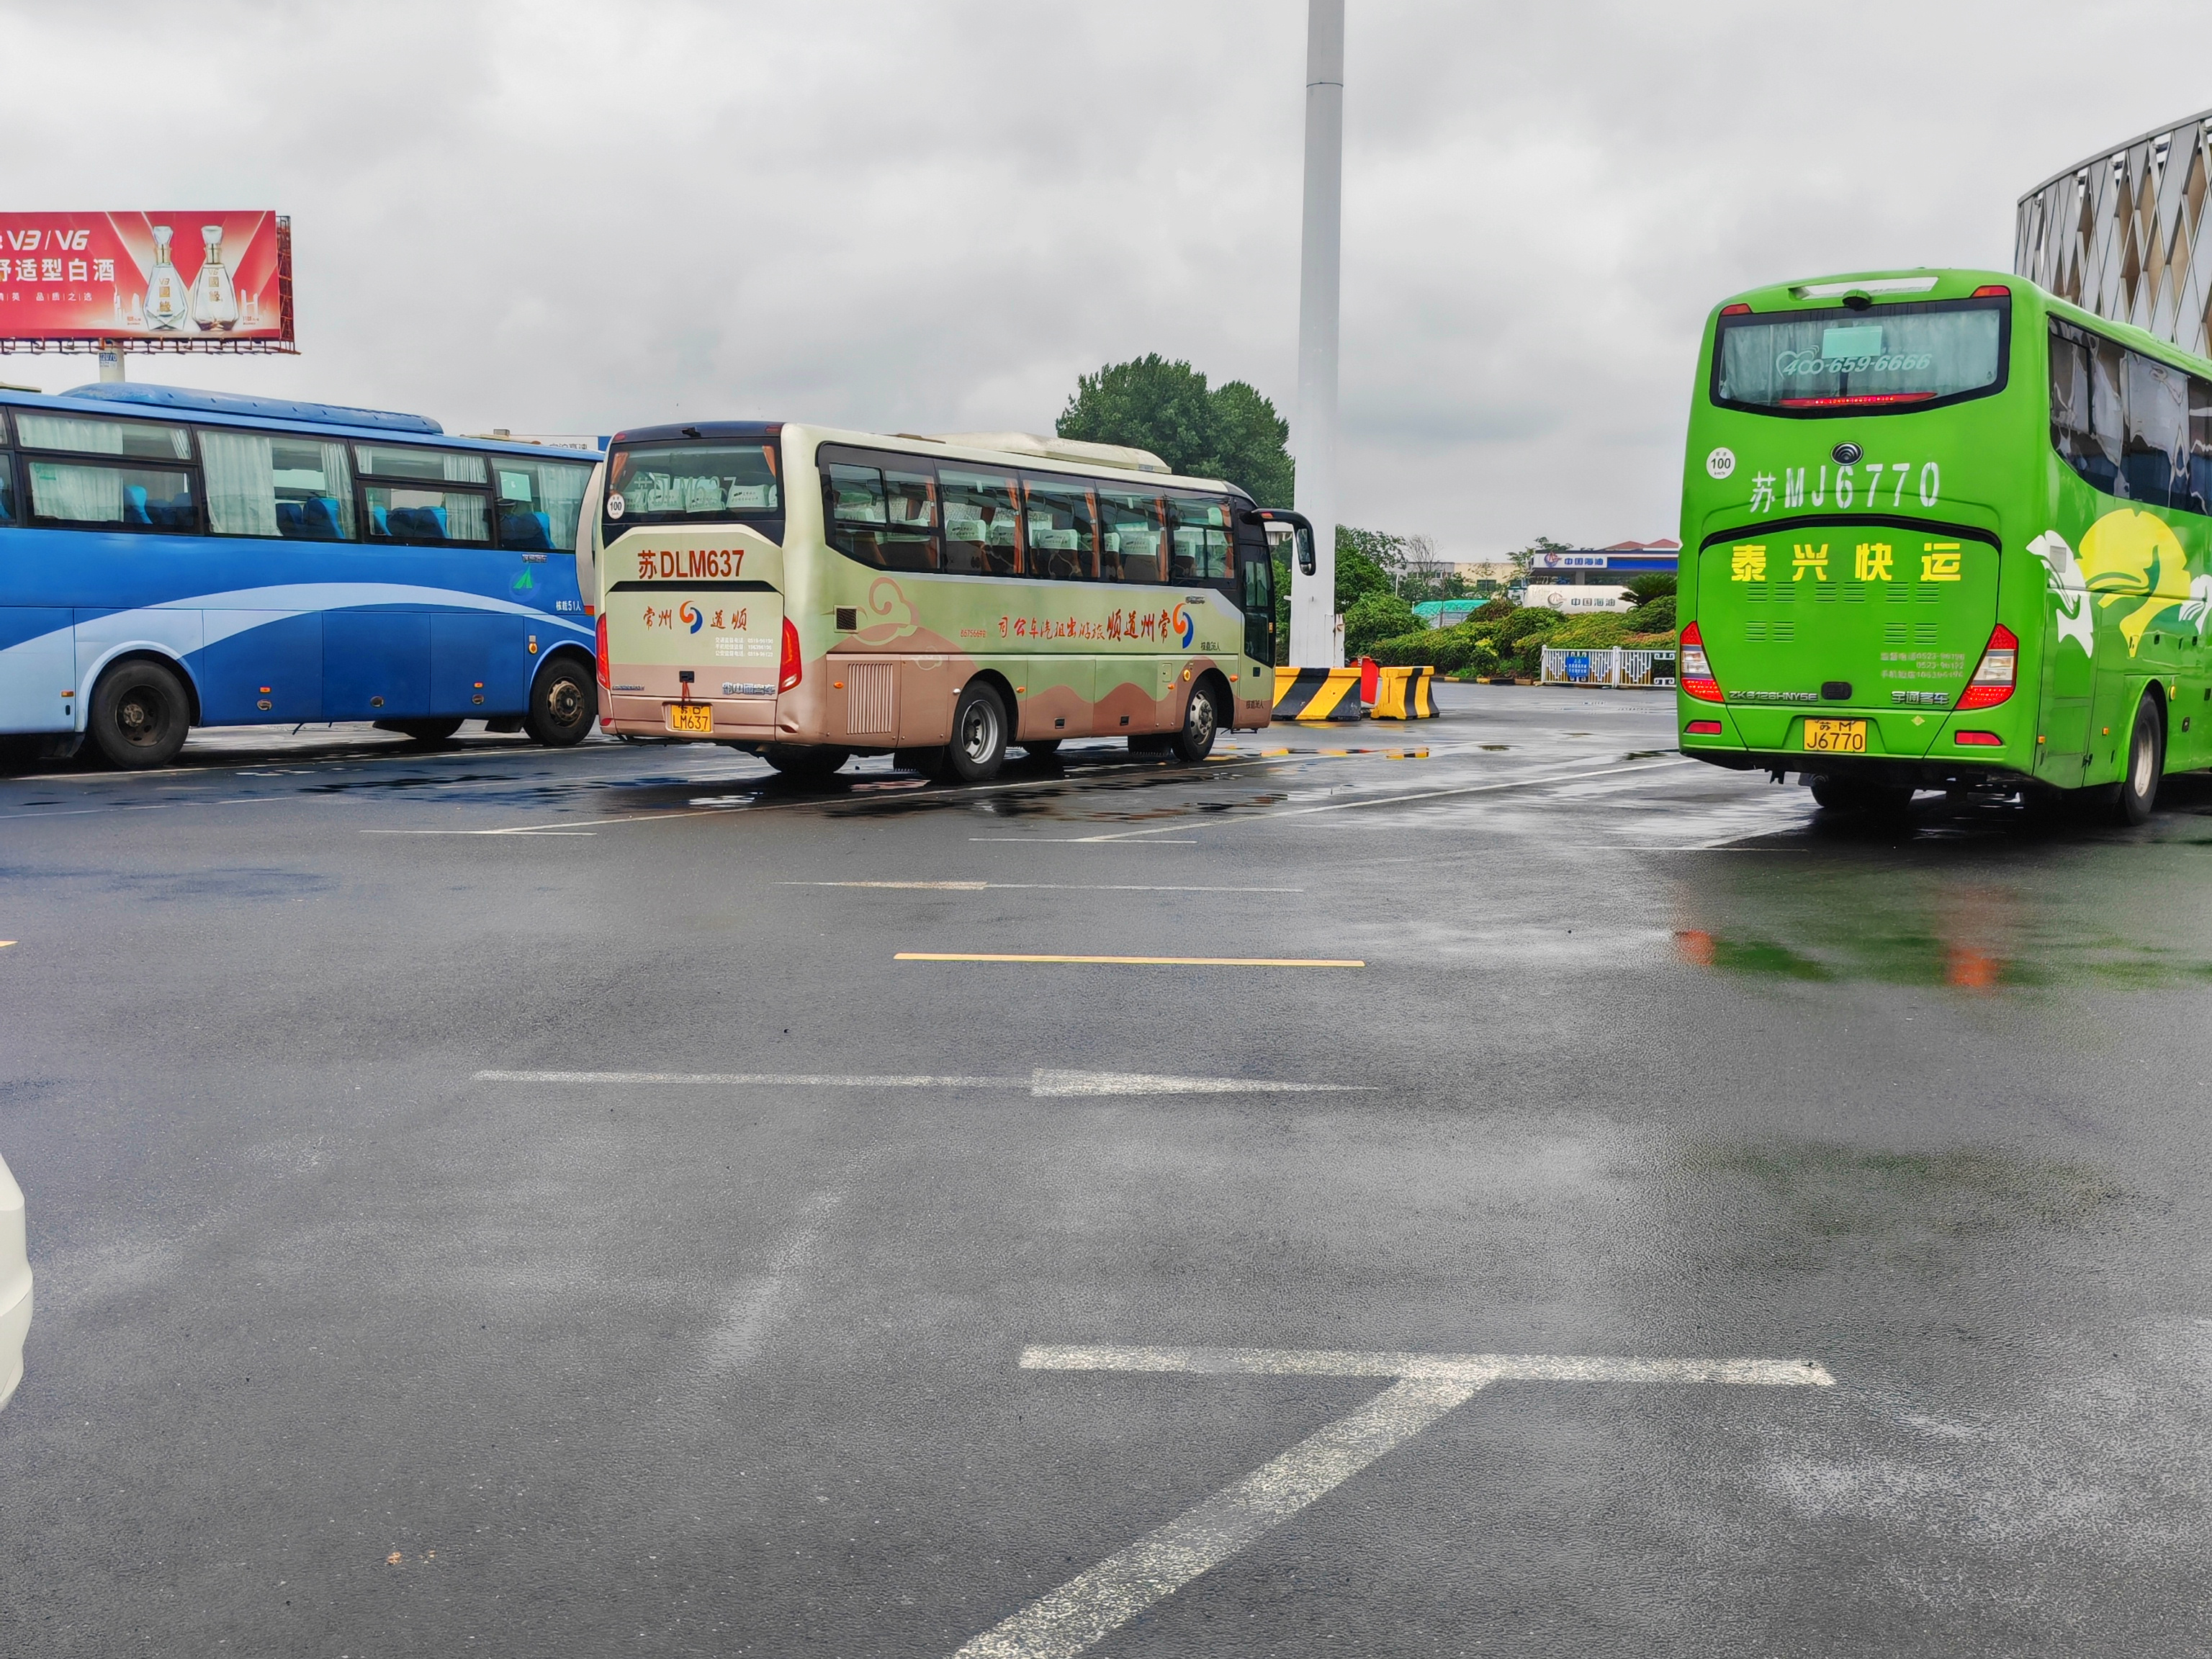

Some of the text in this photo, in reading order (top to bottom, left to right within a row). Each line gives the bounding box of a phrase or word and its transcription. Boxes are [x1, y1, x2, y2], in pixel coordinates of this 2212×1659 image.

[1711, 458, 1731, 469] 100
[1750, 462, 1940, 513] 苏MJ6770
[610, 501, 622, 511] 100
[637, 549, 745, 580] 苏DLM637
[1731, 542, 1961, 582] 泰兴快运
[1571, 598, 1616, 606] 中国海油
[673, 714, 709, 730] LM637
[1807, 732, 1863, 750] J6770
